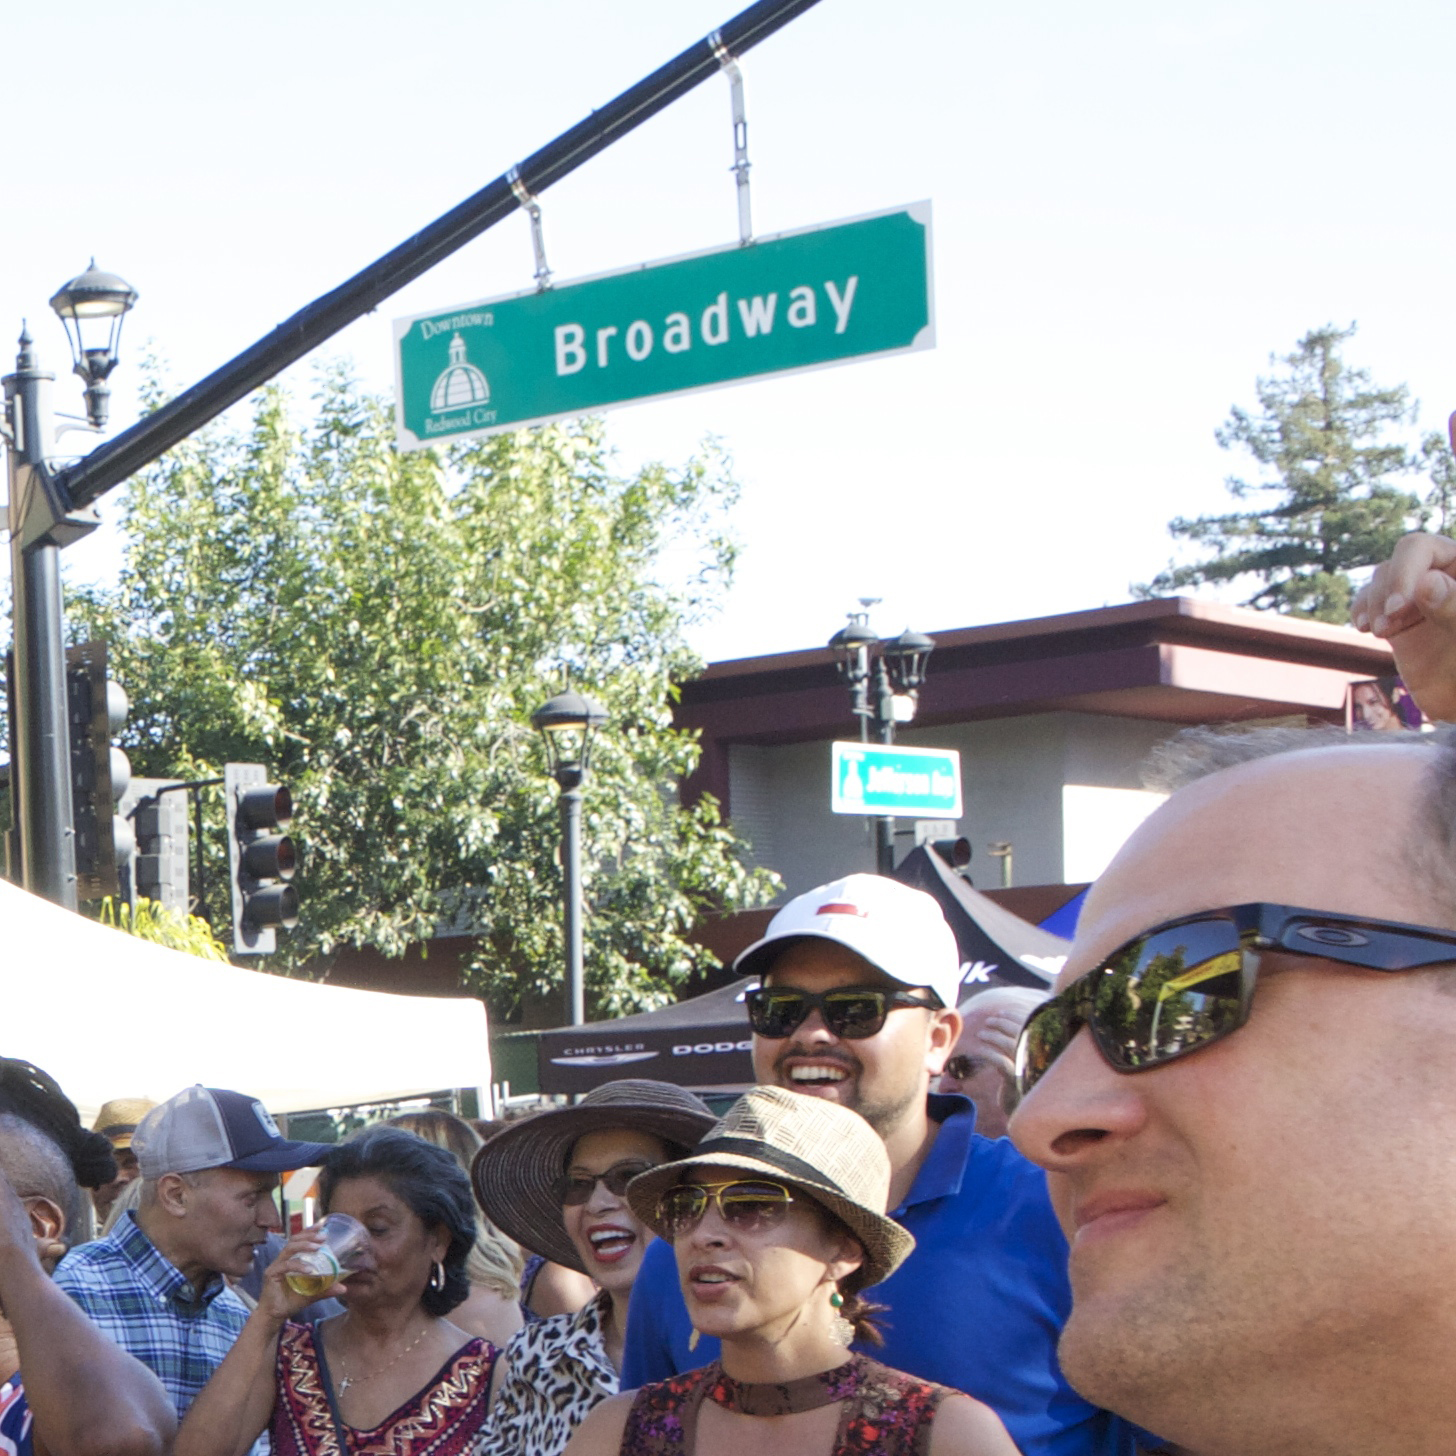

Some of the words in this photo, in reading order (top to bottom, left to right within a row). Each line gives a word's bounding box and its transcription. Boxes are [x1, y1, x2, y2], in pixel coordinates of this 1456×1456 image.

[420, 312, 494, 340] Downtown
[555, 276, 859, 376] Broadway
[424, 410, 471, 433] Redwood
[473, 408, 497, 424] City
[563, 1043, 645, 1056] CHRYSLER
[672, 1040, 753, 1056] DODG
